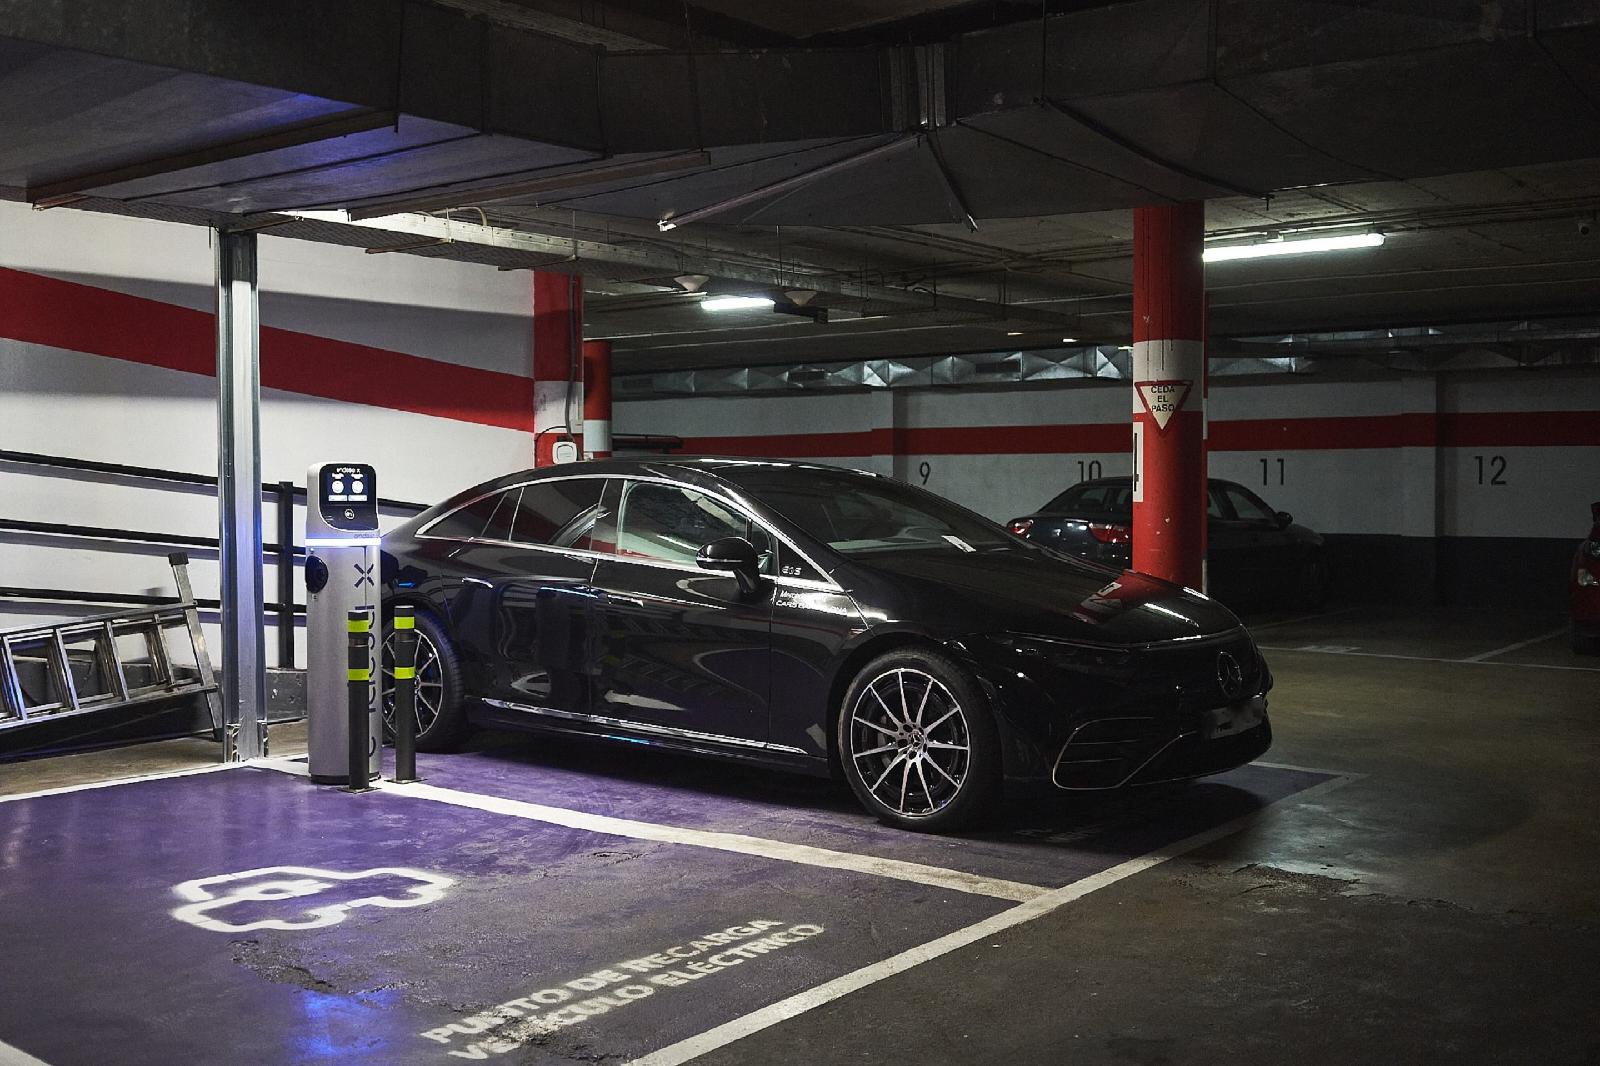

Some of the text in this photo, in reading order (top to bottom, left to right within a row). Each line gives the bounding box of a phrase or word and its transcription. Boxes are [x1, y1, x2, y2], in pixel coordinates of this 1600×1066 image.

[1151, 385, 1175, 394] CEDA
[1157, 395, 1168, 403] EL
[1151, 404, 1175, 412] PASO
[919, 463, 931, 484] 9
[1078, 461, 1101, 482] 10
[1261, 459, 1284, 485] 11
[1475, 456, 1507, 485] 12
[565, 969, 632, 991] DE
[618, 919, 784, 973] RECARGA
